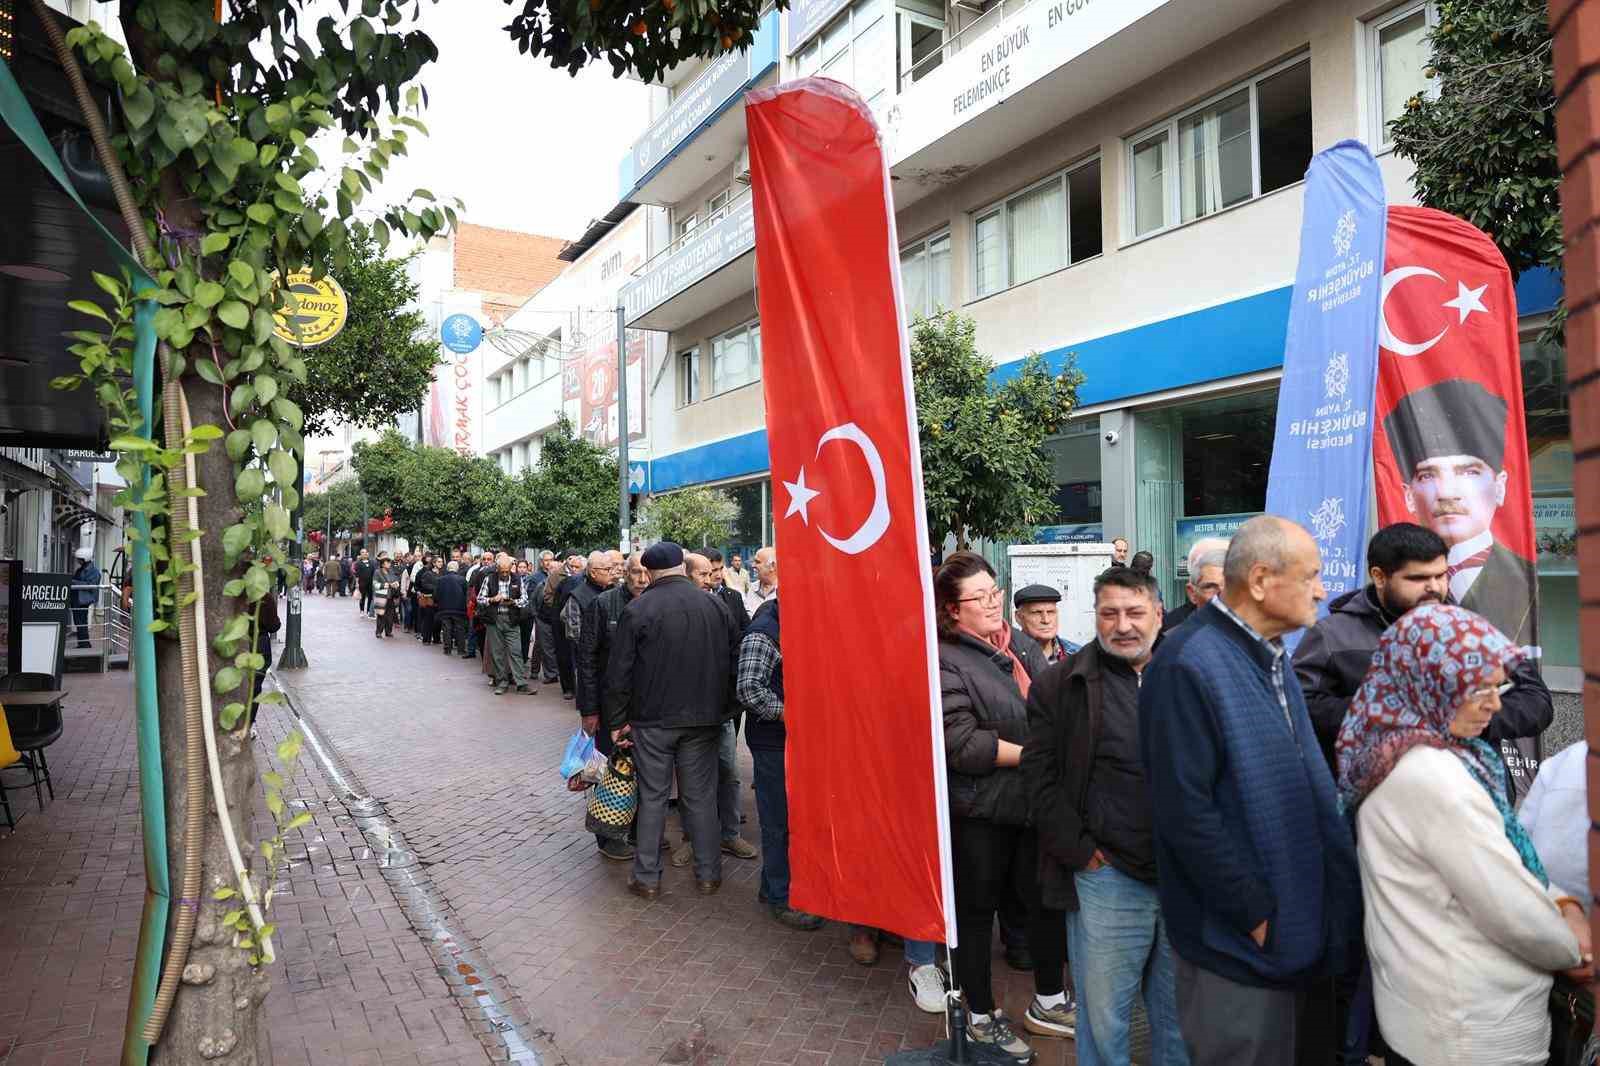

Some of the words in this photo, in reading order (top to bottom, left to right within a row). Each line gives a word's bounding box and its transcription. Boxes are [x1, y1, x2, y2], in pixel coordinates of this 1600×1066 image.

[1048, 3, 1063, 29] EN
[981, 52, 994, 73] EN
[996, 24, 1030, 63] BÜYÜK
[953, 65, 1011, 115] FELEMENKÇE
[601, 250, 622, 280] avm
[1507, 756, 1537, 768] EHİR
